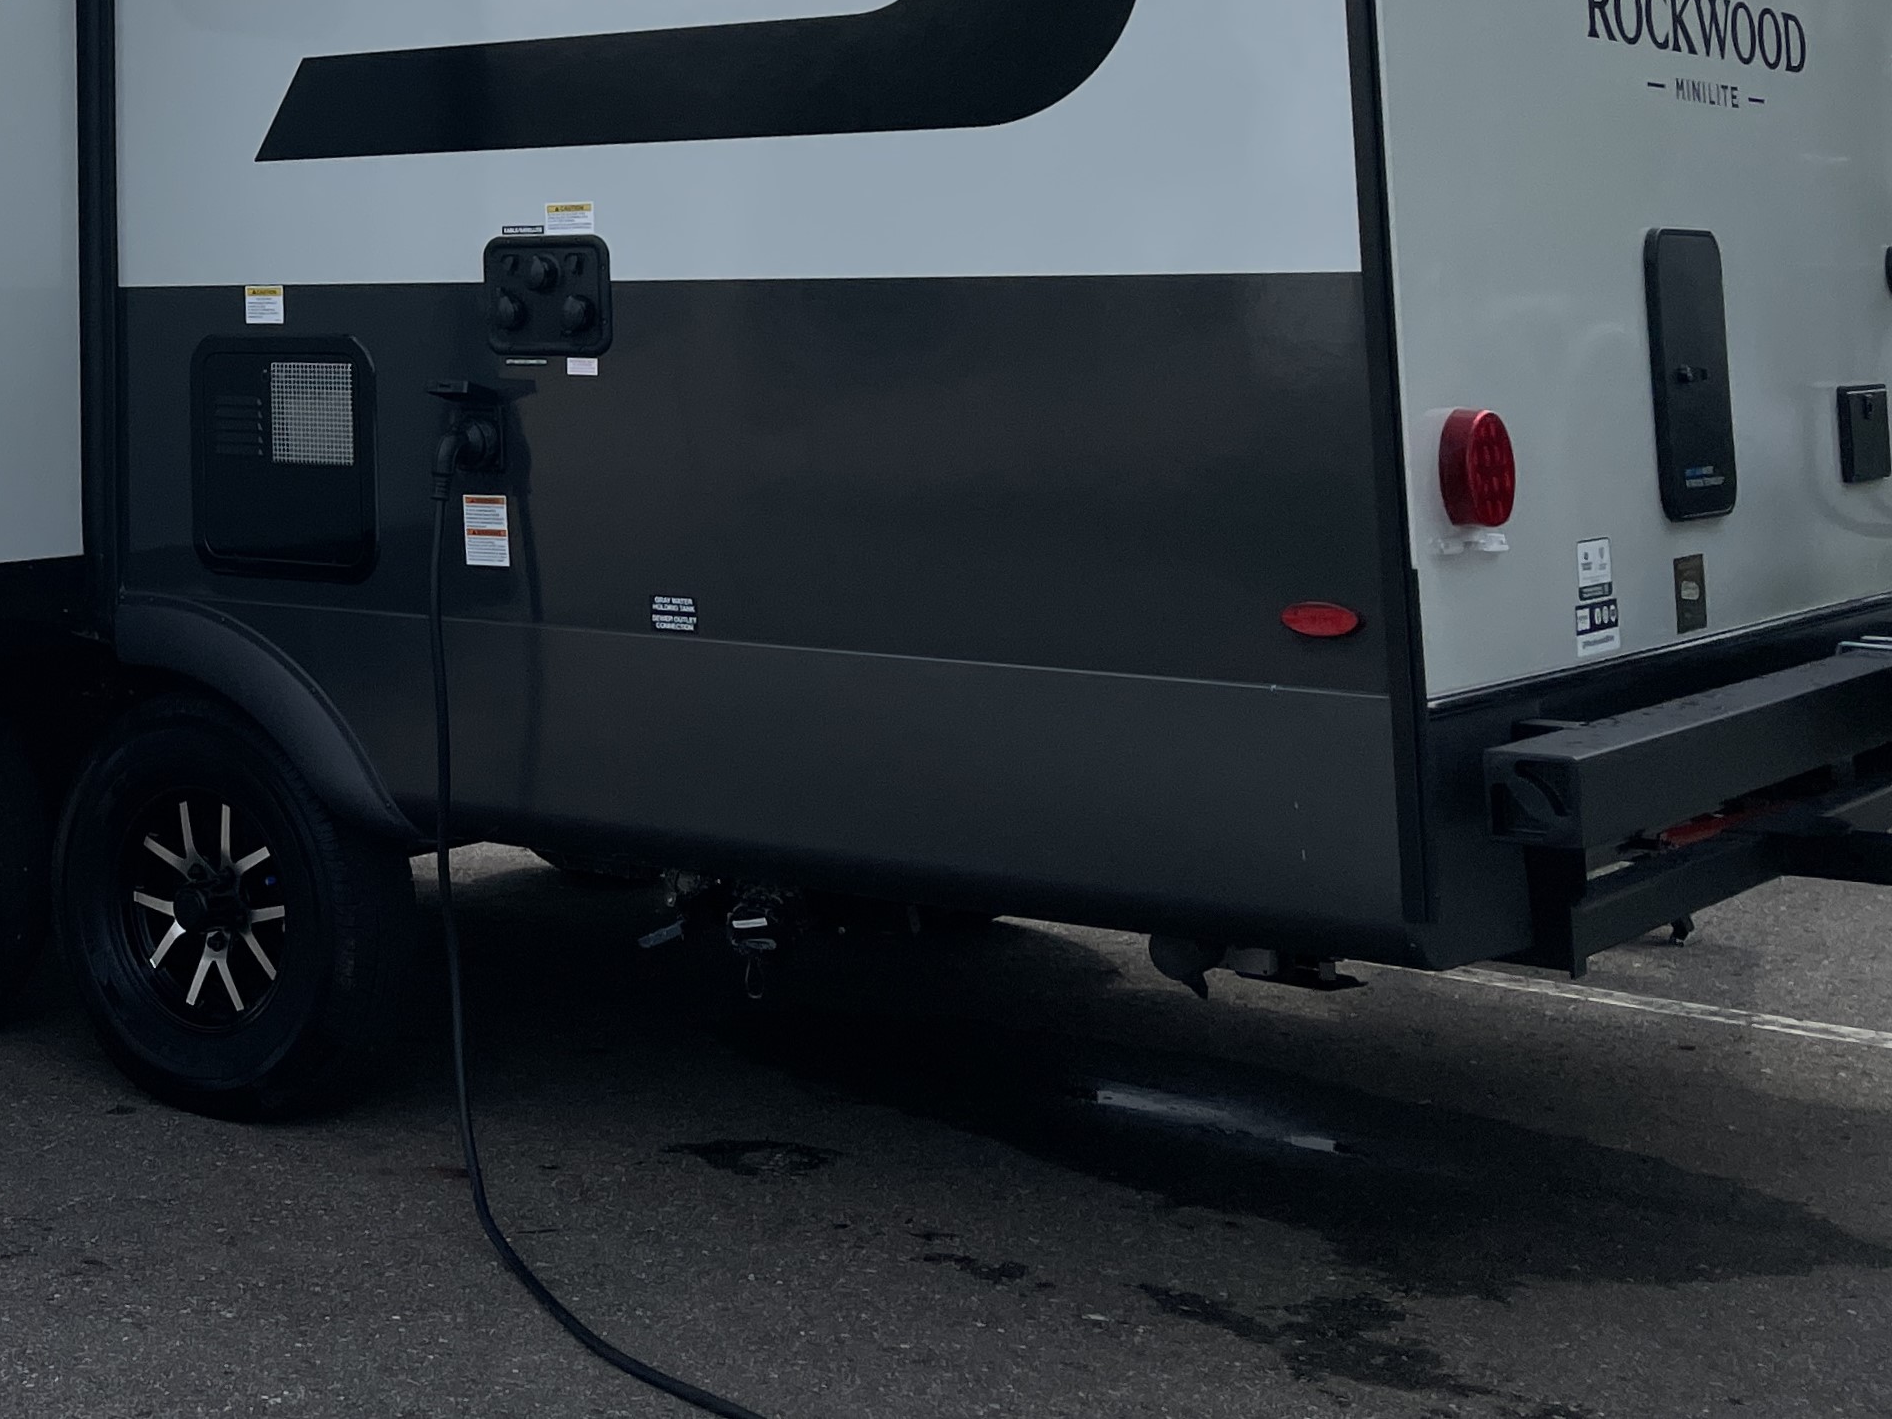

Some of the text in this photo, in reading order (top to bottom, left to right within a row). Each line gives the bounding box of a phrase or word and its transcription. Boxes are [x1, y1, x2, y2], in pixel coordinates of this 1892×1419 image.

[1675, 77, 1740, 109] MINILITE
[672, 597, 693, 605] WATER
[652, 603, 678, 611] HOLDING
[652, 614, 697, 624] SEWER OUTLET
[656, 622, 694, 630] CONNECTION
